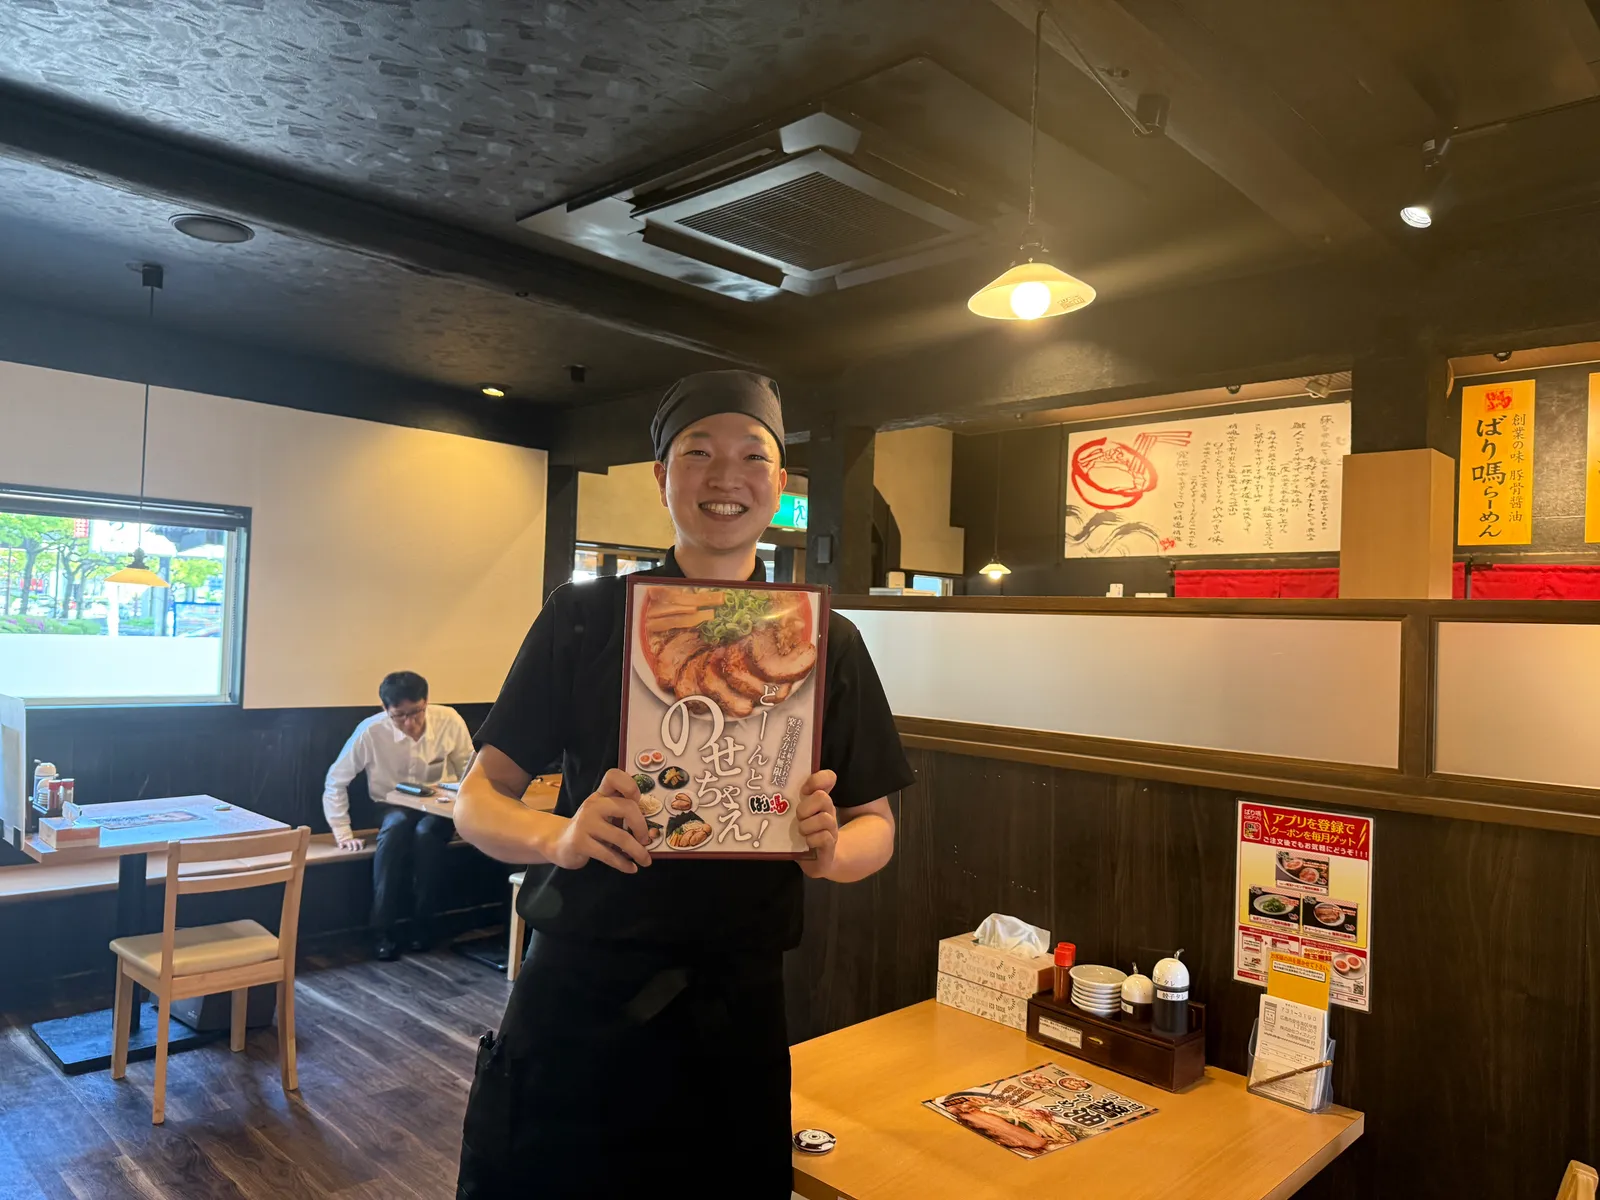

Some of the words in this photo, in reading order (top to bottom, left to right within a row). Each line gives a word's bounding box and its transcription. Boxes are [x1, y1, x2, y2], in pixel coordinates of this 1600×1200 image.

[1510, 413, 1526, 464] 創業の味
[1471, 414, 1507, 538] ばり嗎らーめん
[1508, 468, 1525, 523] 豚骨醤油
[745, 684, 780, 791] どーんと
[770, 716, 797, 786] 楽しみ方は無限大
[1270, 826, 1357, 847] クーポンを毎月ゲット
[1272, 813, 1356, 835] アプリを登録で
[1162, 992, 1186, 1000] 餃子タレ
